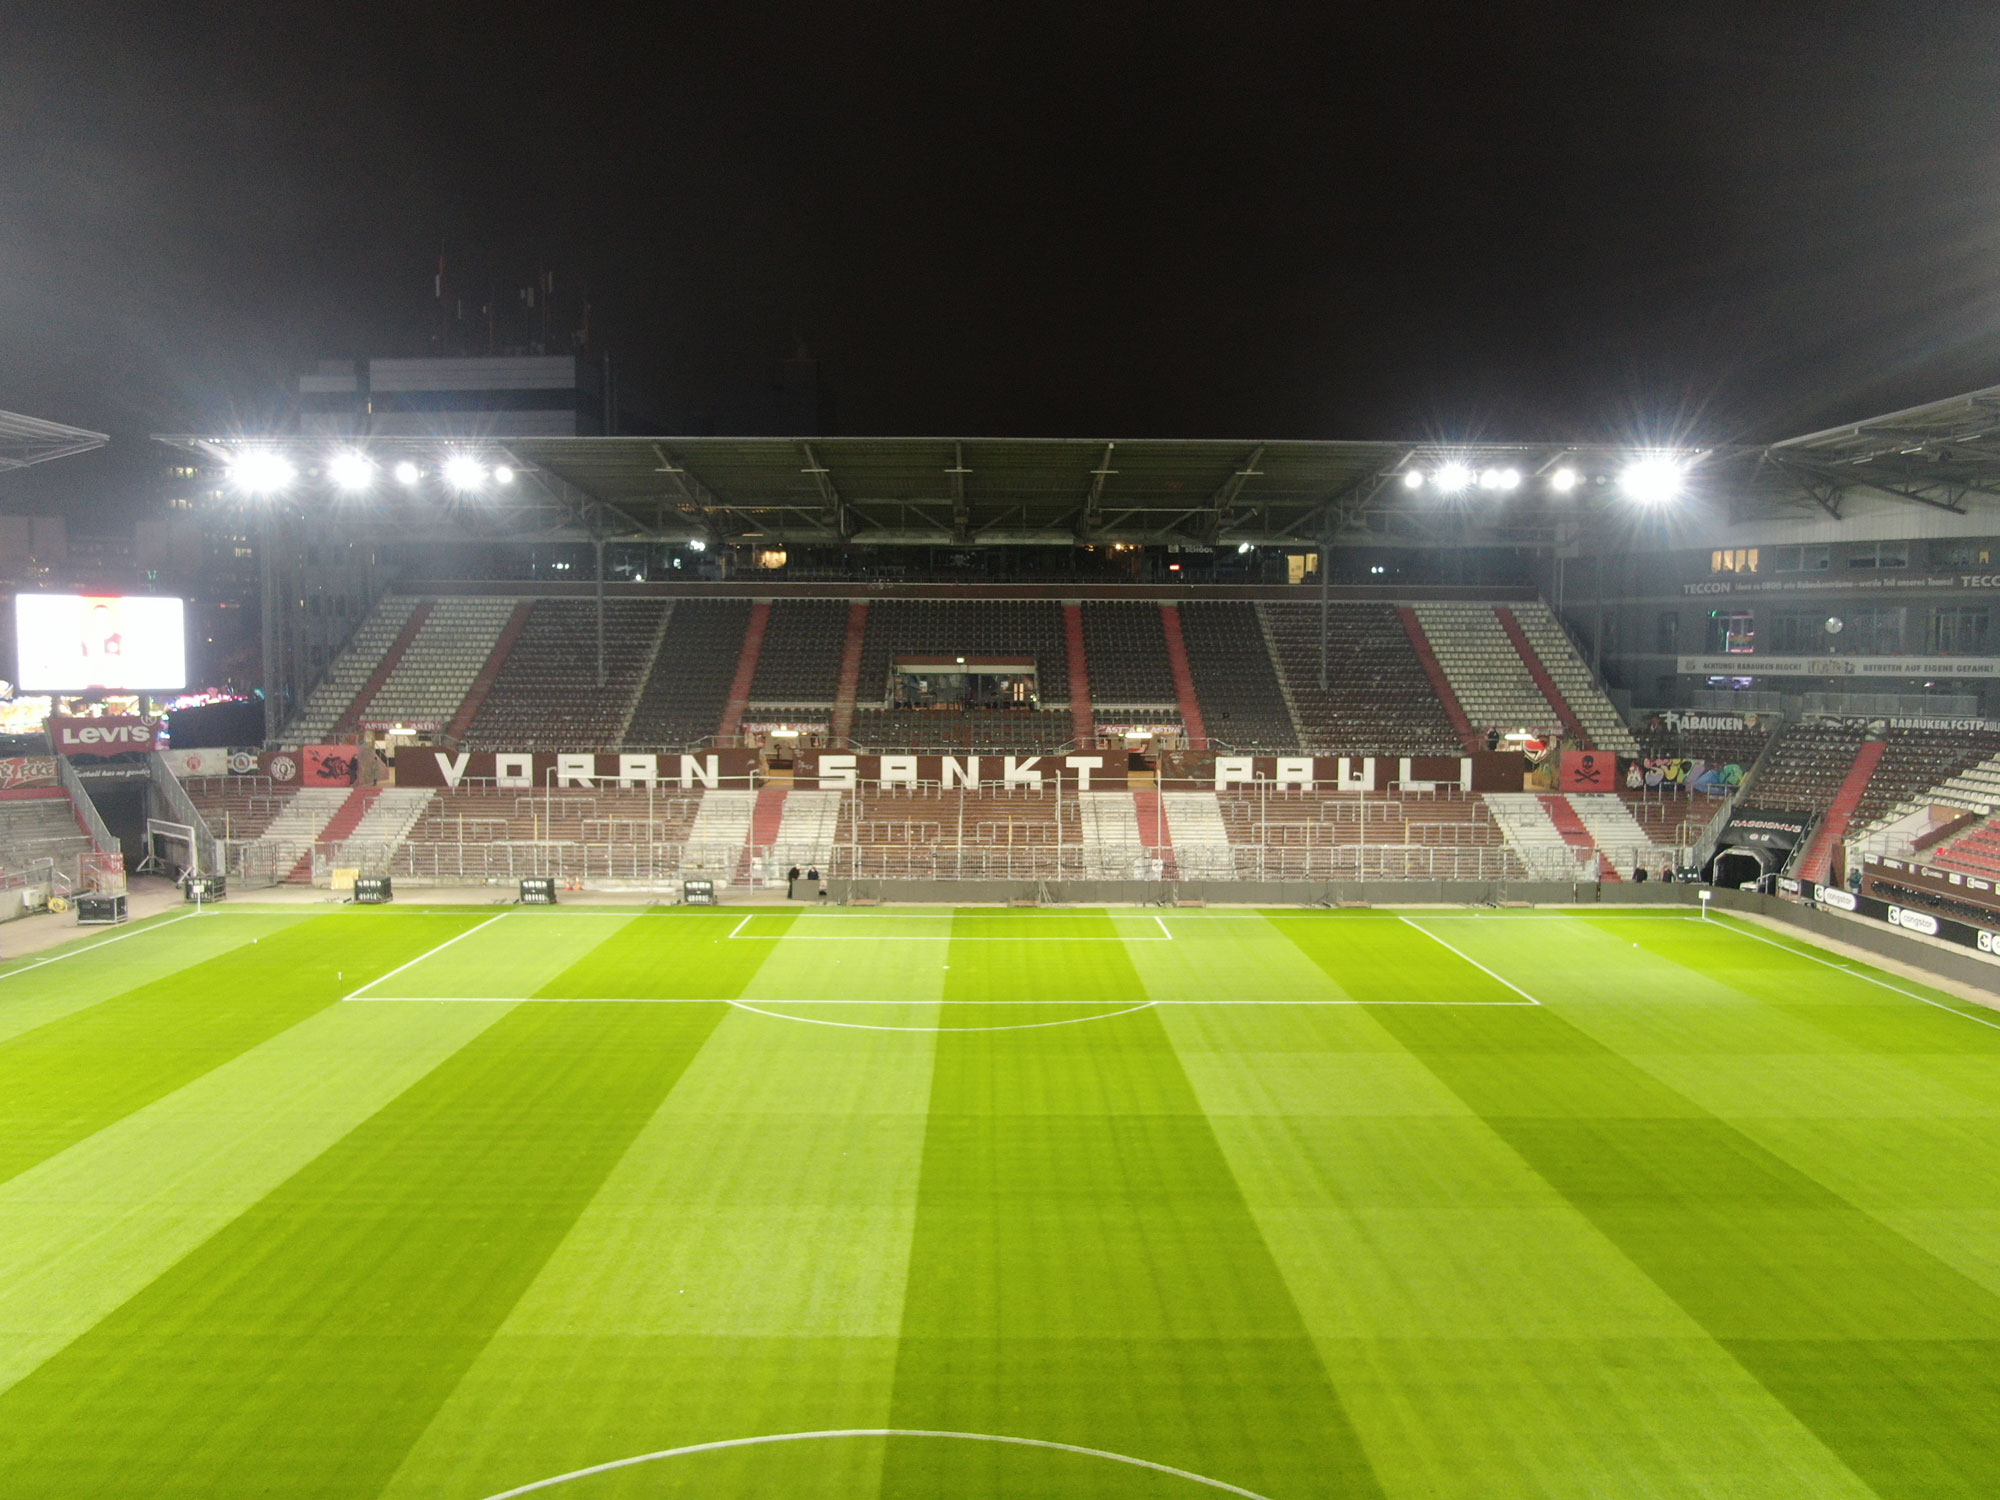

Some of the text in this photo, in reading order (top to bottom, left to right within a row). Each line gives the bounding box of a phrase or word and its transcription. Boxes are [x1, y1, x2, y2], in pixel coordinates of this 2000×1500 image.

[1683, 582, 1731, 595] TECCON
[1905, 664, 1920, 672] AUF
[1924, 664, 1954, 673] EIGENE
[1956, 663, 1994, 673] GEFAHR!
[1659, 710, 1743, 734] RABAUKEN
[434, 753, 1473, 792] VORAN SANKT PAULI
[1729, 819, 1802, 833] RASSISMUS
[1903, 914, 1933, 927] congstar
